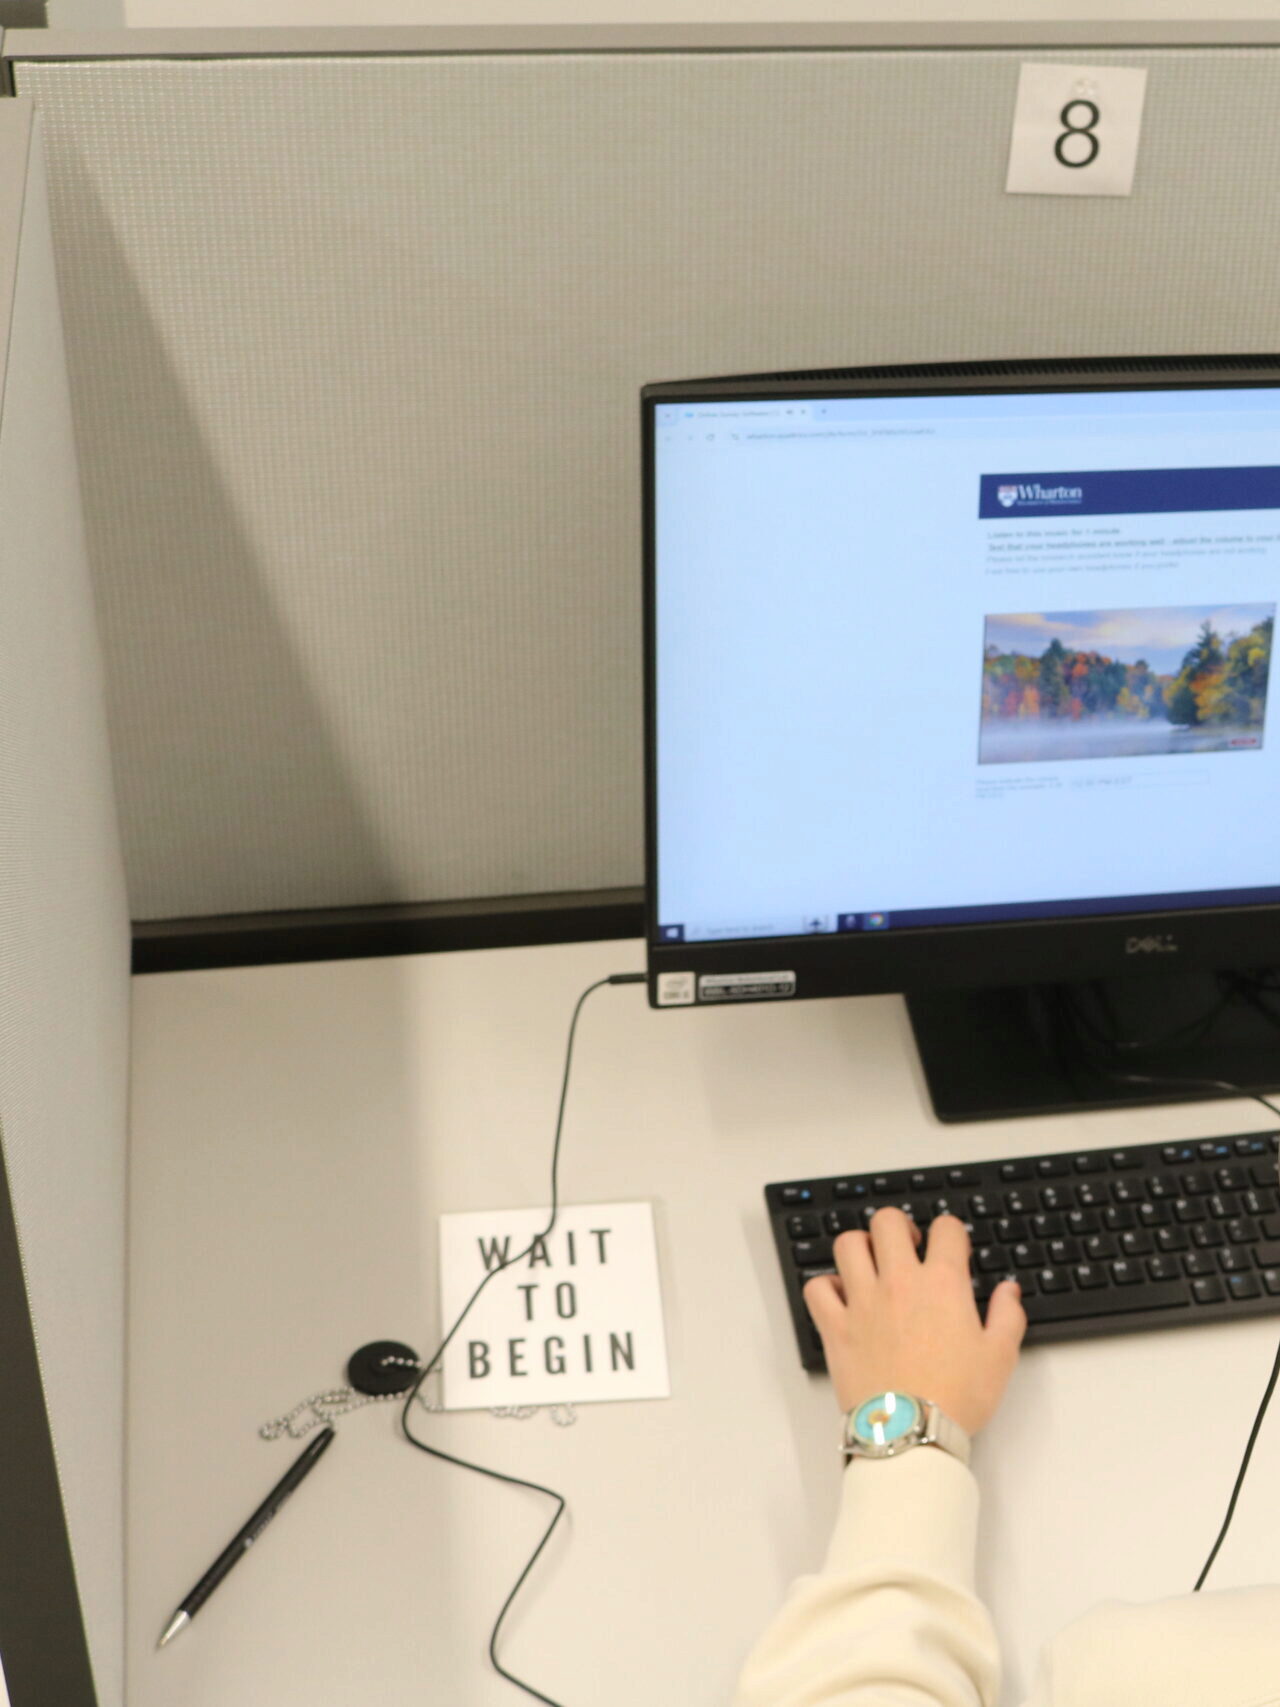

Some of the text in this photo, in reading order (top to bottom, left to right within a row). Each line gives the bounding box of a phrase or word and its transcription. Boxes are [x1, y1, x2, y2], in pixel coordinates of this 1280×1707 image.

[1054, 100, 1099, 168] 8
[1018, 484, 1083, 500] Wharton
[478, 1229, 612, 1271] WAIT
[518, 1282, 576, 1321] TO
[469, 1332, 634, 1379] BEGIN
